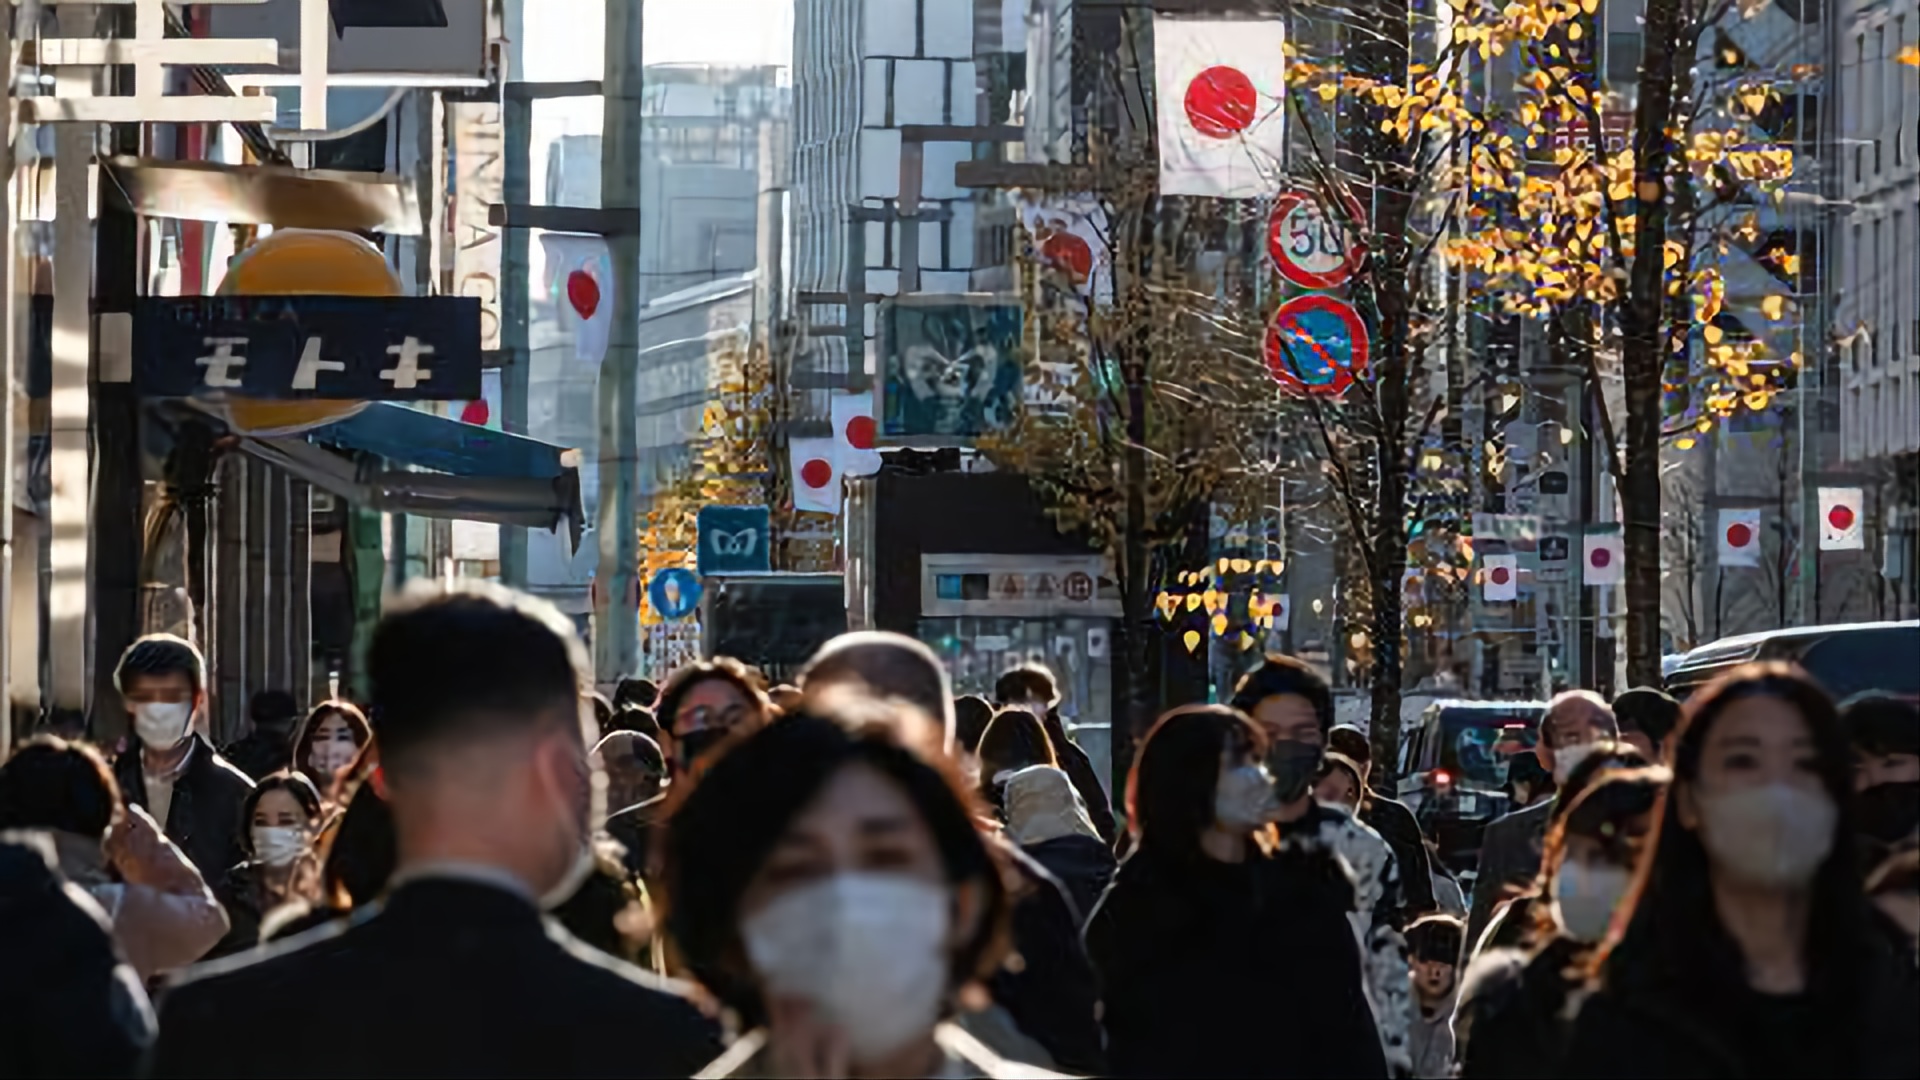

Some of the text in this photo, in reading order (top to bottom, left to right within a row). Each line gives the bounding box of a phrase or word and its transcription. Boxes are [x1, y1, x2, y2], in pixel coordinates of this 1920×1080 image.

[1290, 211, 1345, 258] 50
[195, 336, 435, 389] モトキ
